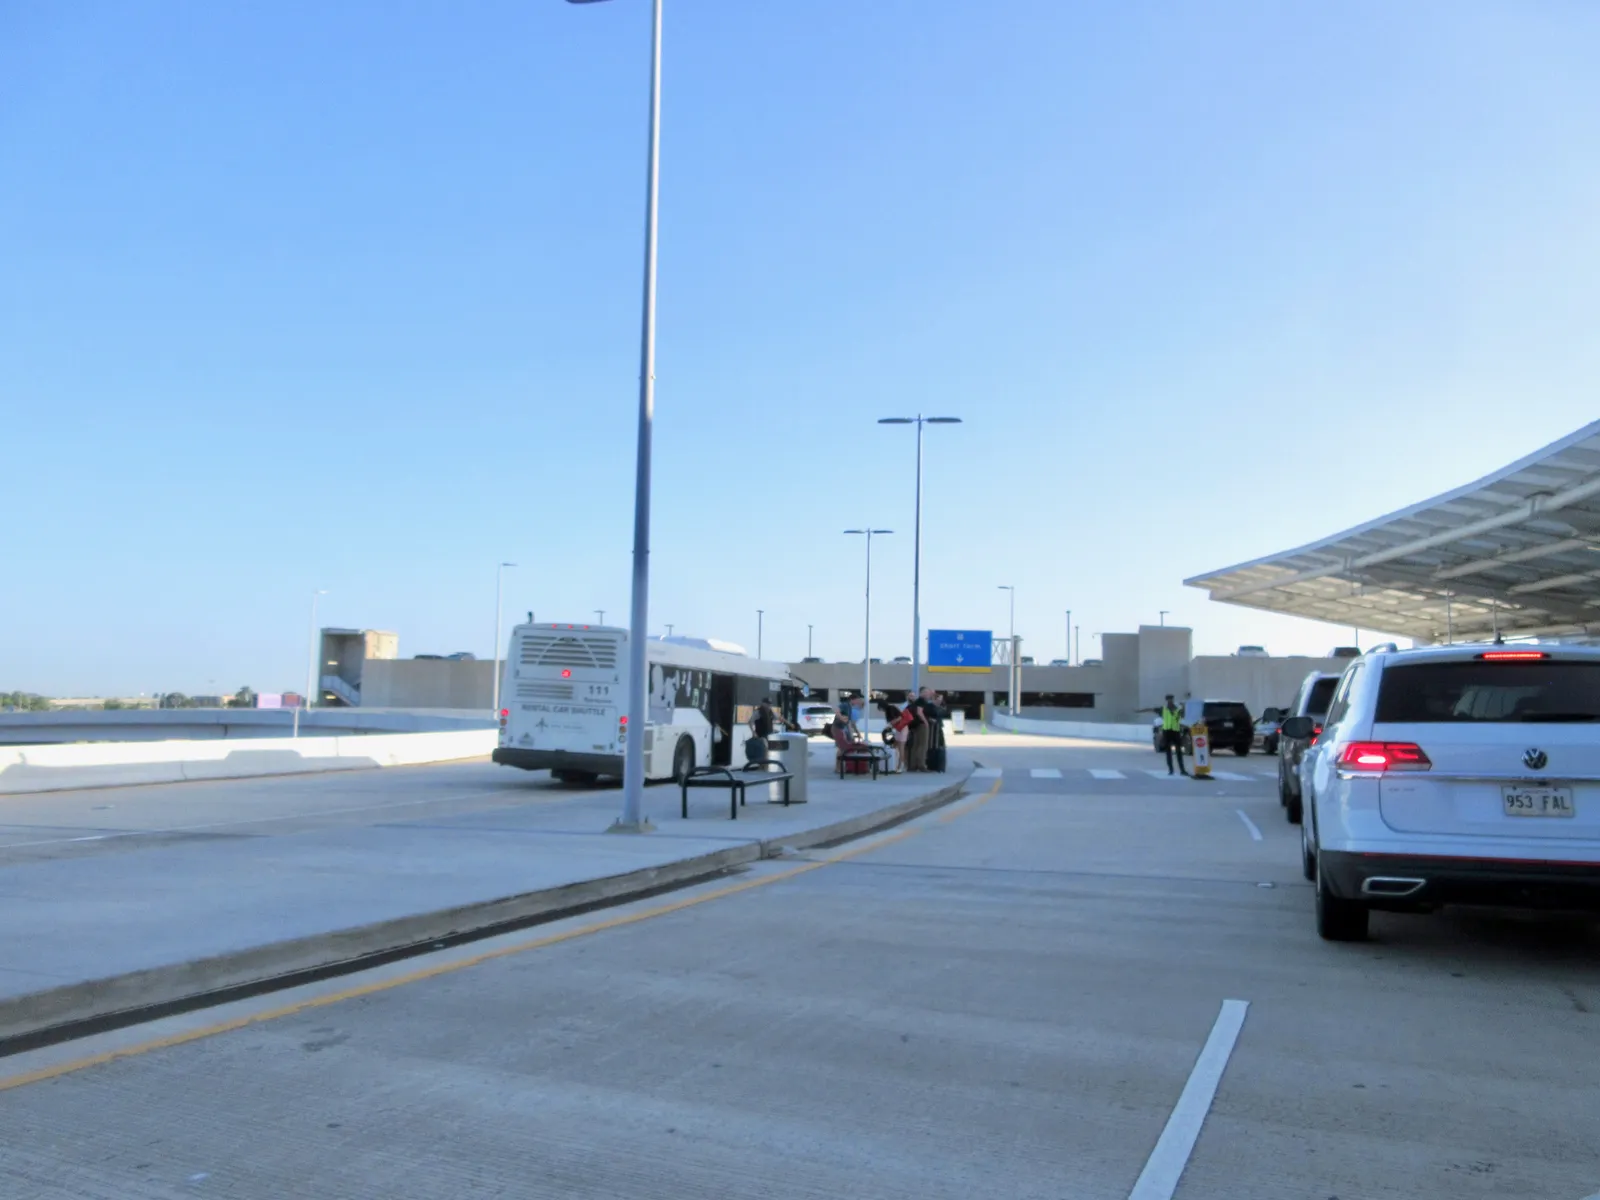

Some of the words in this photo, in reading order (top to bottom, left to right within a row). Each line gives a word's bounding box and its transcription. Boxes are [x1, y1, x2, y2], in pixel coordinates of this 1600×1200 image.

[588, 685, 610, 696] 111
[521, 704, 550, 713] RENTAL
[553, 706, 570, 714] CAR
[571, 707, 606, 716] SHUTTLE
[1507, 795, 1533, 809] 953
[1542, 796, 1570, 811] FAL
